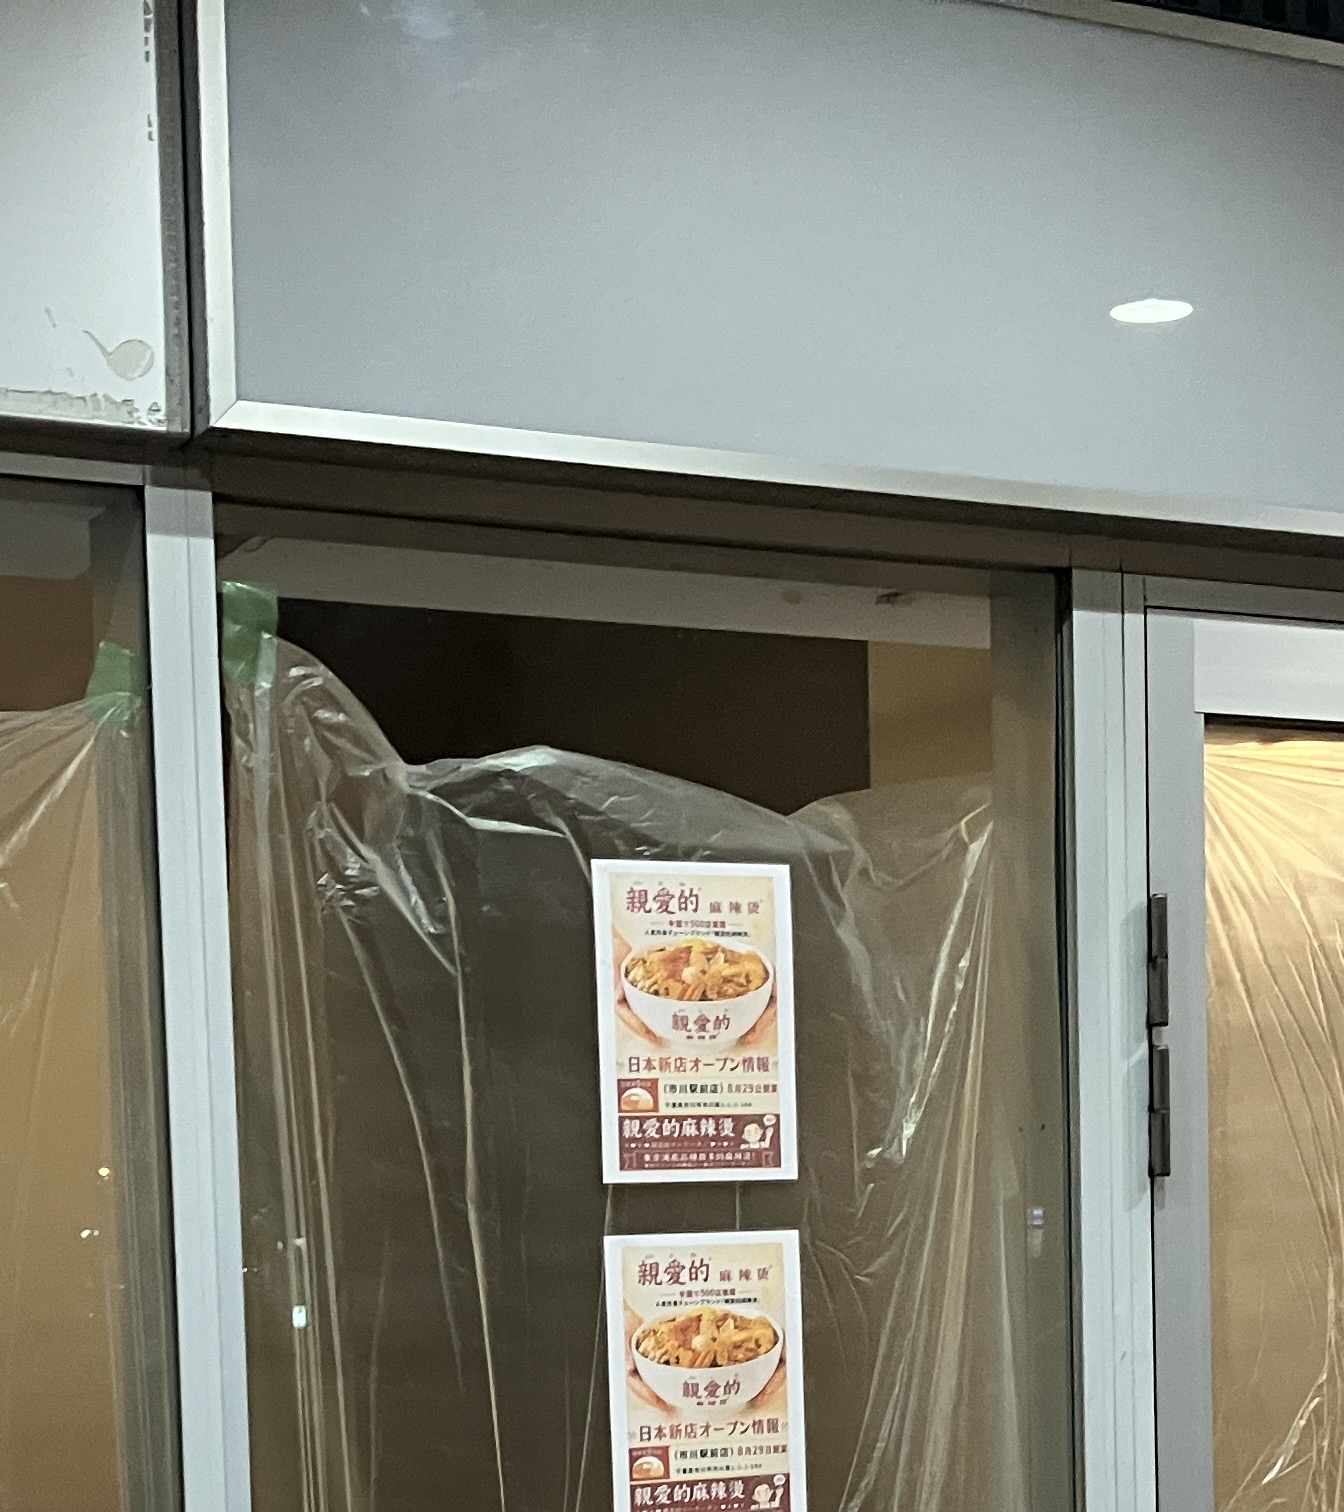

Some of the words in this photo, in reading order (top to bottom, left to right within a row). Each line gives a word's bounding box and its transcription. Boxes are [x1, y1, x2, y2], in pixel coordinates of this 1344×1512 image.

[626, 887, 700, 915] 親愛的
[671, 1013, 731, 1033] 親愛的
[628, 1056, 771, 1074] 日本新店オープン情報
[637, 1259, 711, 1287] 親愛的
[682, 1378, 741, 1399] 親愛的
[639, 1417, 780, 1443] 日本新店オープン情報
